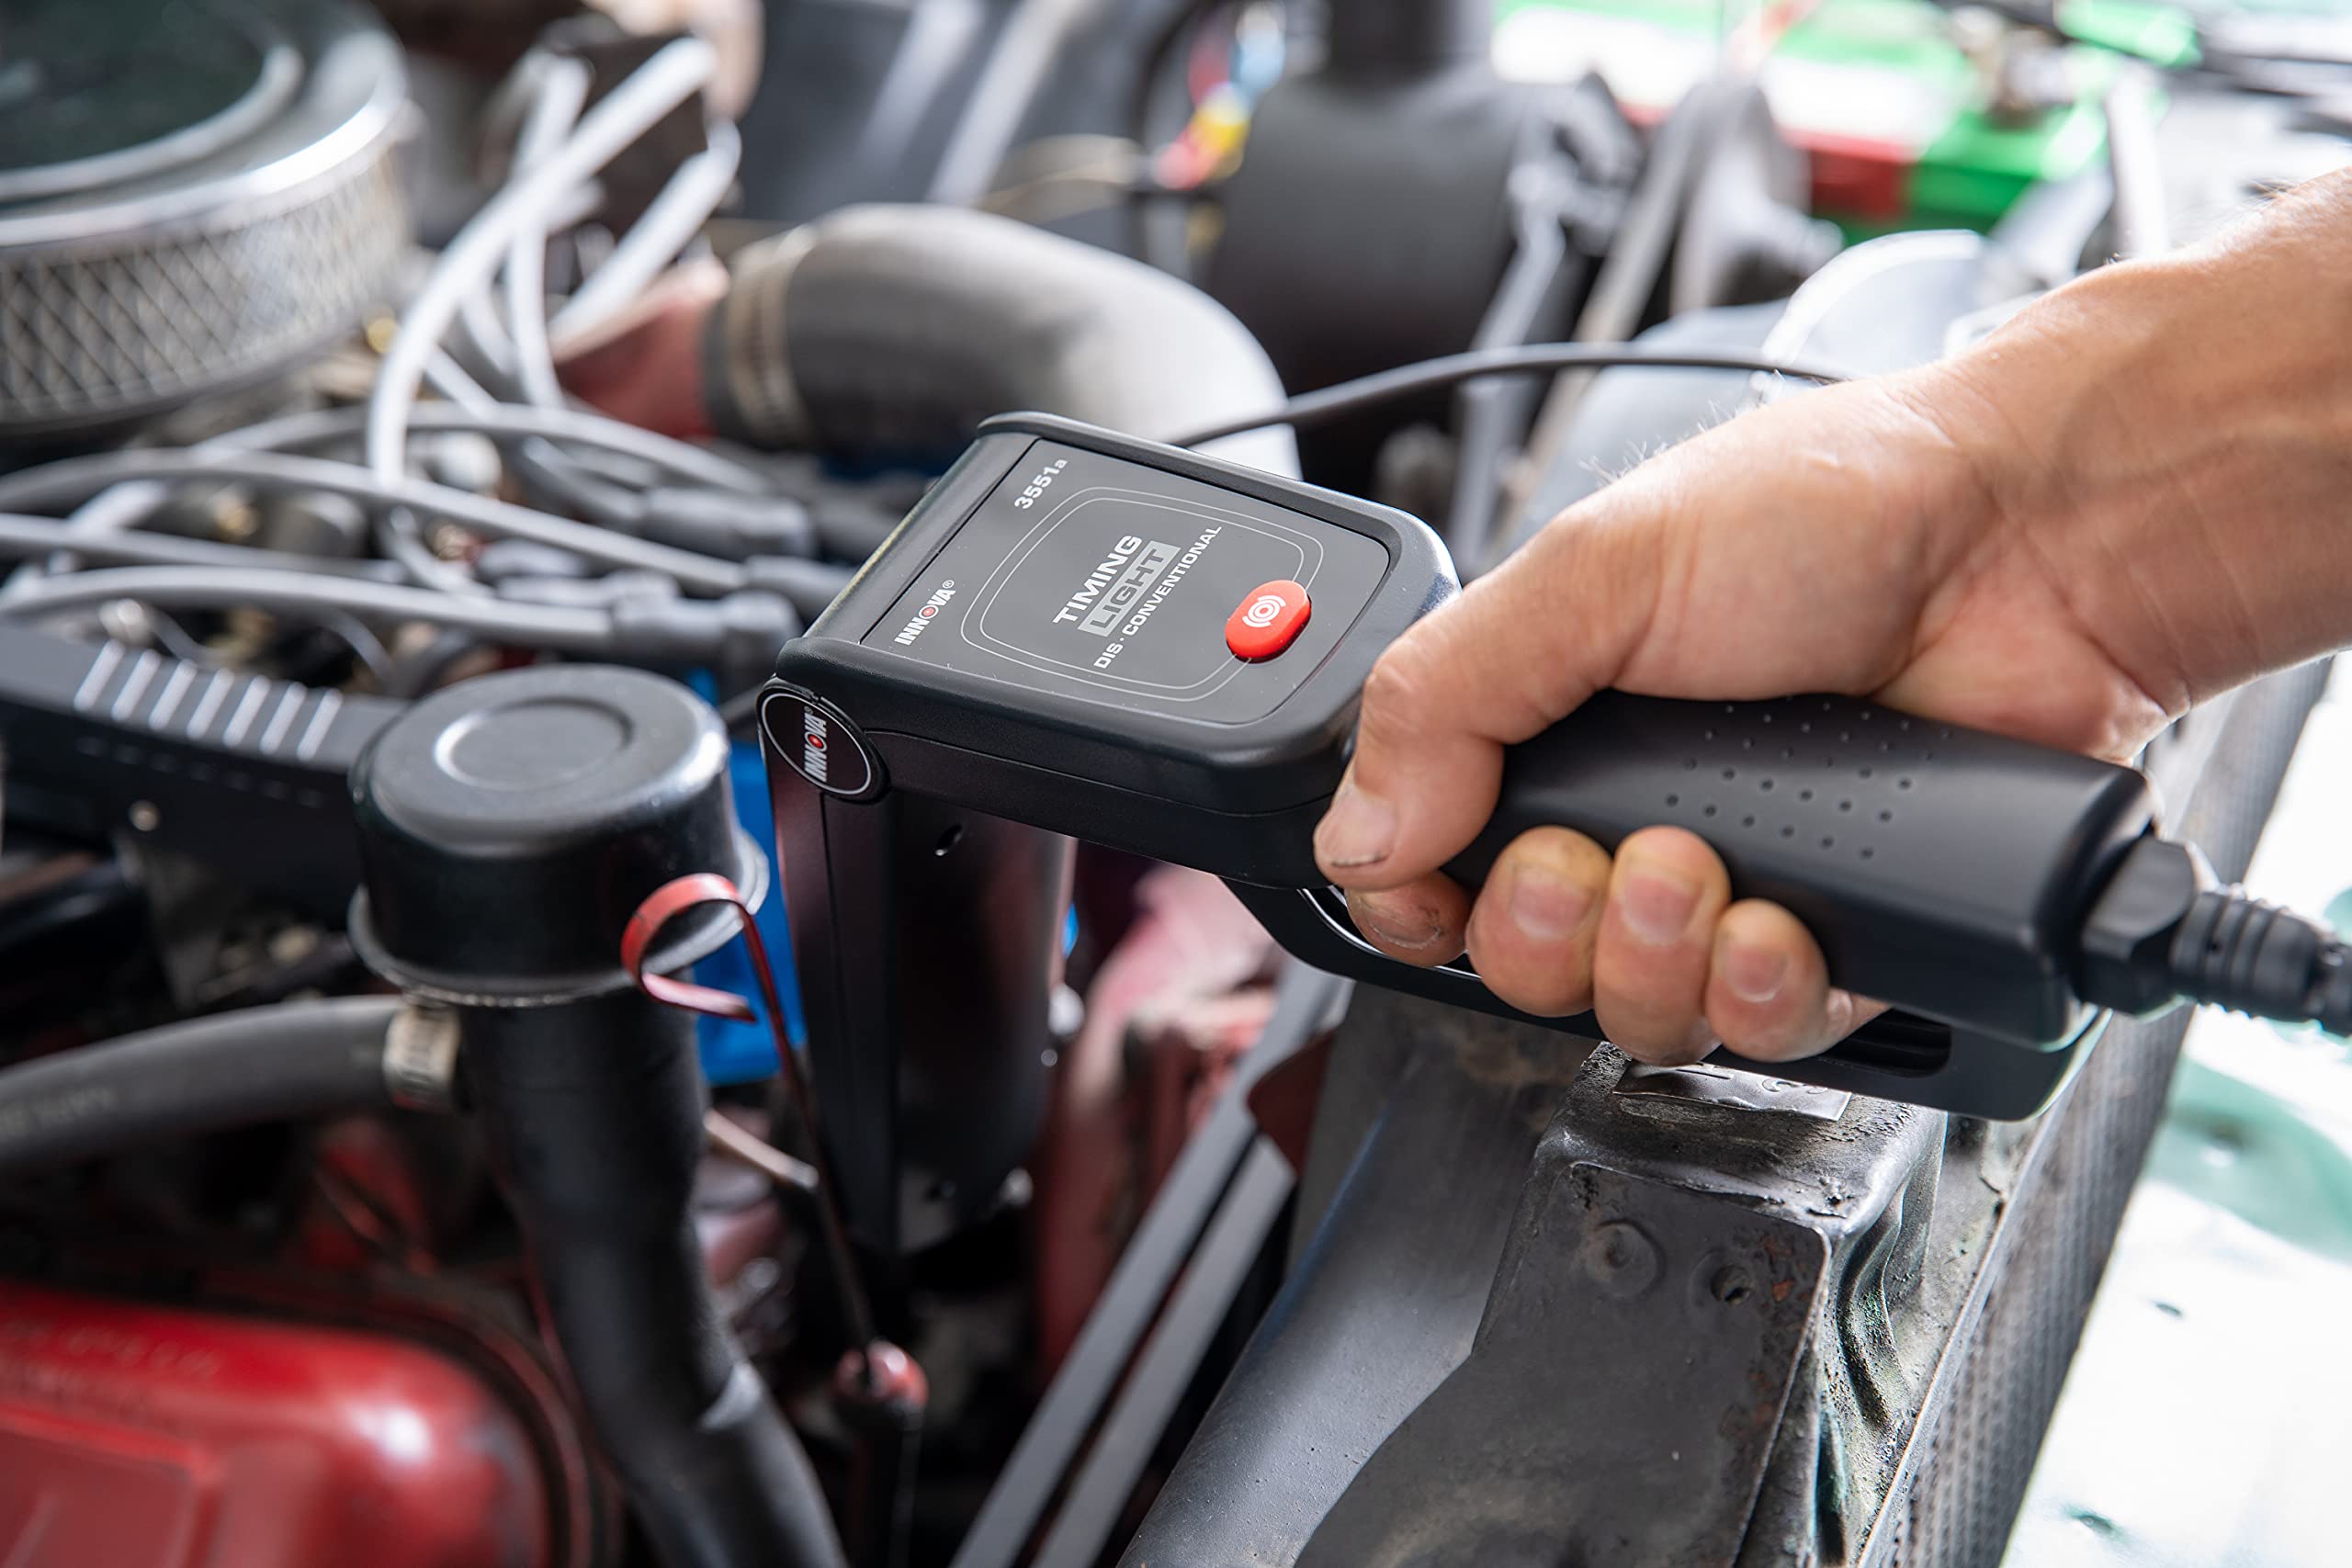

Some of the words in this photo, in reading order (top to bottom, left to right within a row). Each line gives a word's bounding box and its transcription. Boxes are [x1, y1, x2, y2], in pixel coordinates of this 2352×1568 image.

[1013, 458, 1069, 510] 3551a
[1052, 535, 1143, 624] TIMING
[1089, 547, 1165, 629] LIGHT
[1093, 642, 1124, 669] DIS
[1121, 525, 1223, 636] CONVENTIONAL
